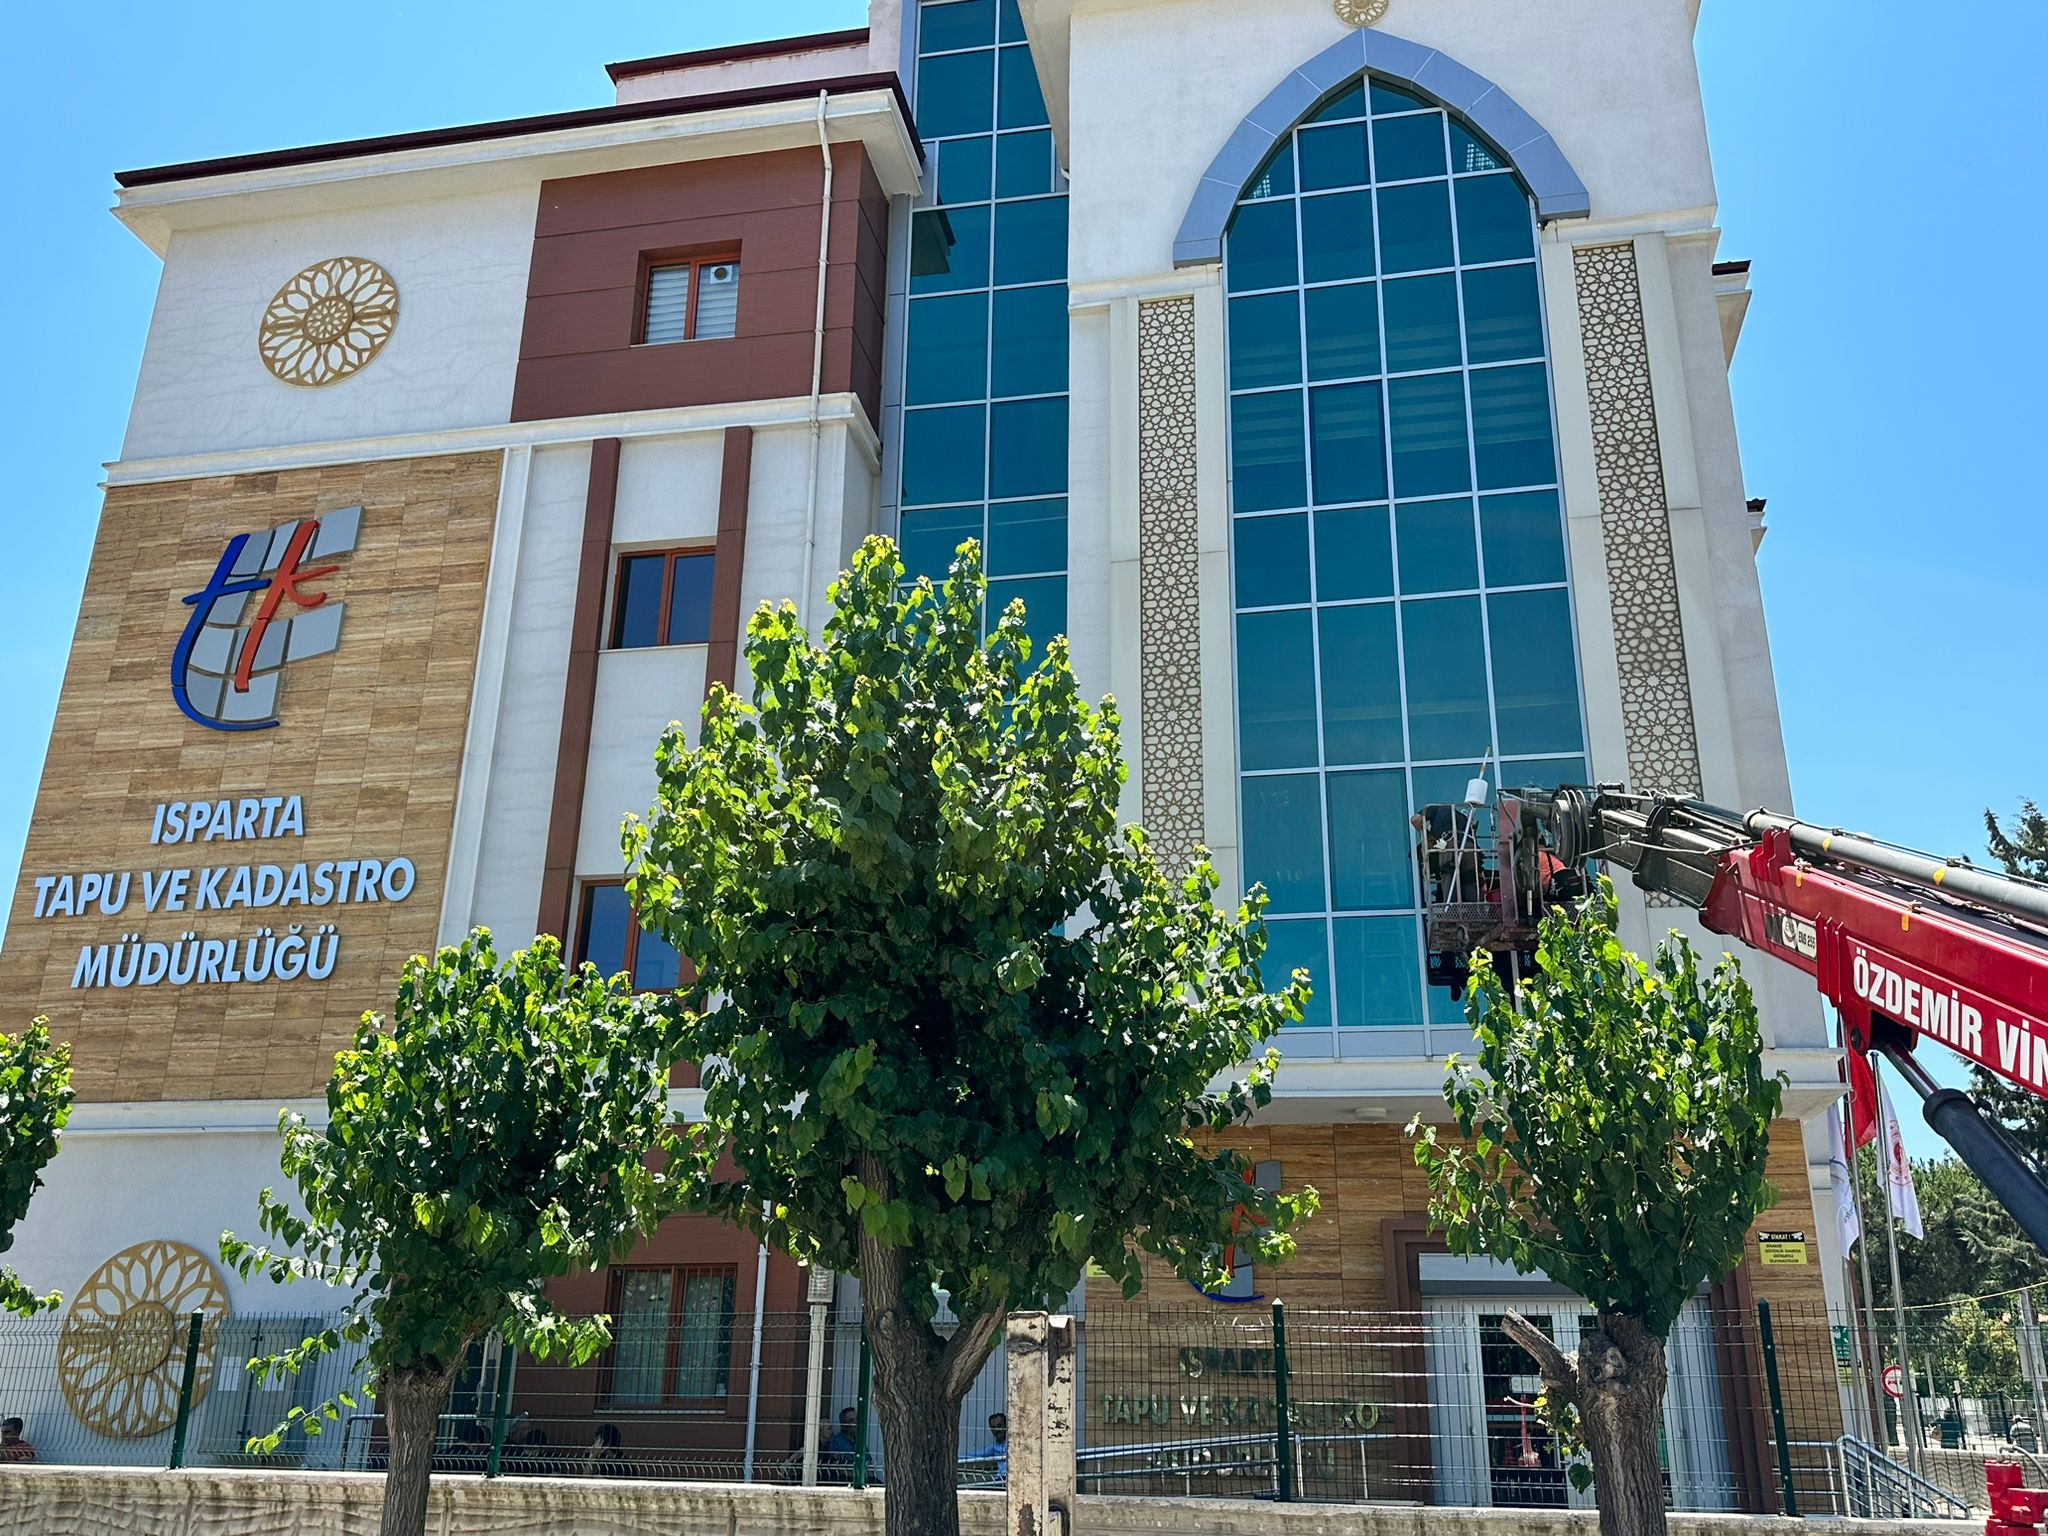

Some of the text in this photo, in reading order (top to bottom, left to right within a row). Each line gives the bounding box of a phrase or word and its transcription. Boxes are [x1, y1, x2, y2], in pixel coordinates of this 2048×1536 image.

[150, 795, 304, 845] ISPARTA
[33, 856, 416, 918] TAPU VE KADASTRO
[71, 924, 340, 989] MÜDÜRLÜĞÜ
[1853, 946, 1982, 1058] ÖZDEMİR
[1102, 1393, 1170, 1426] TAPU
[1180, 1394, 1214, 1426] VE
